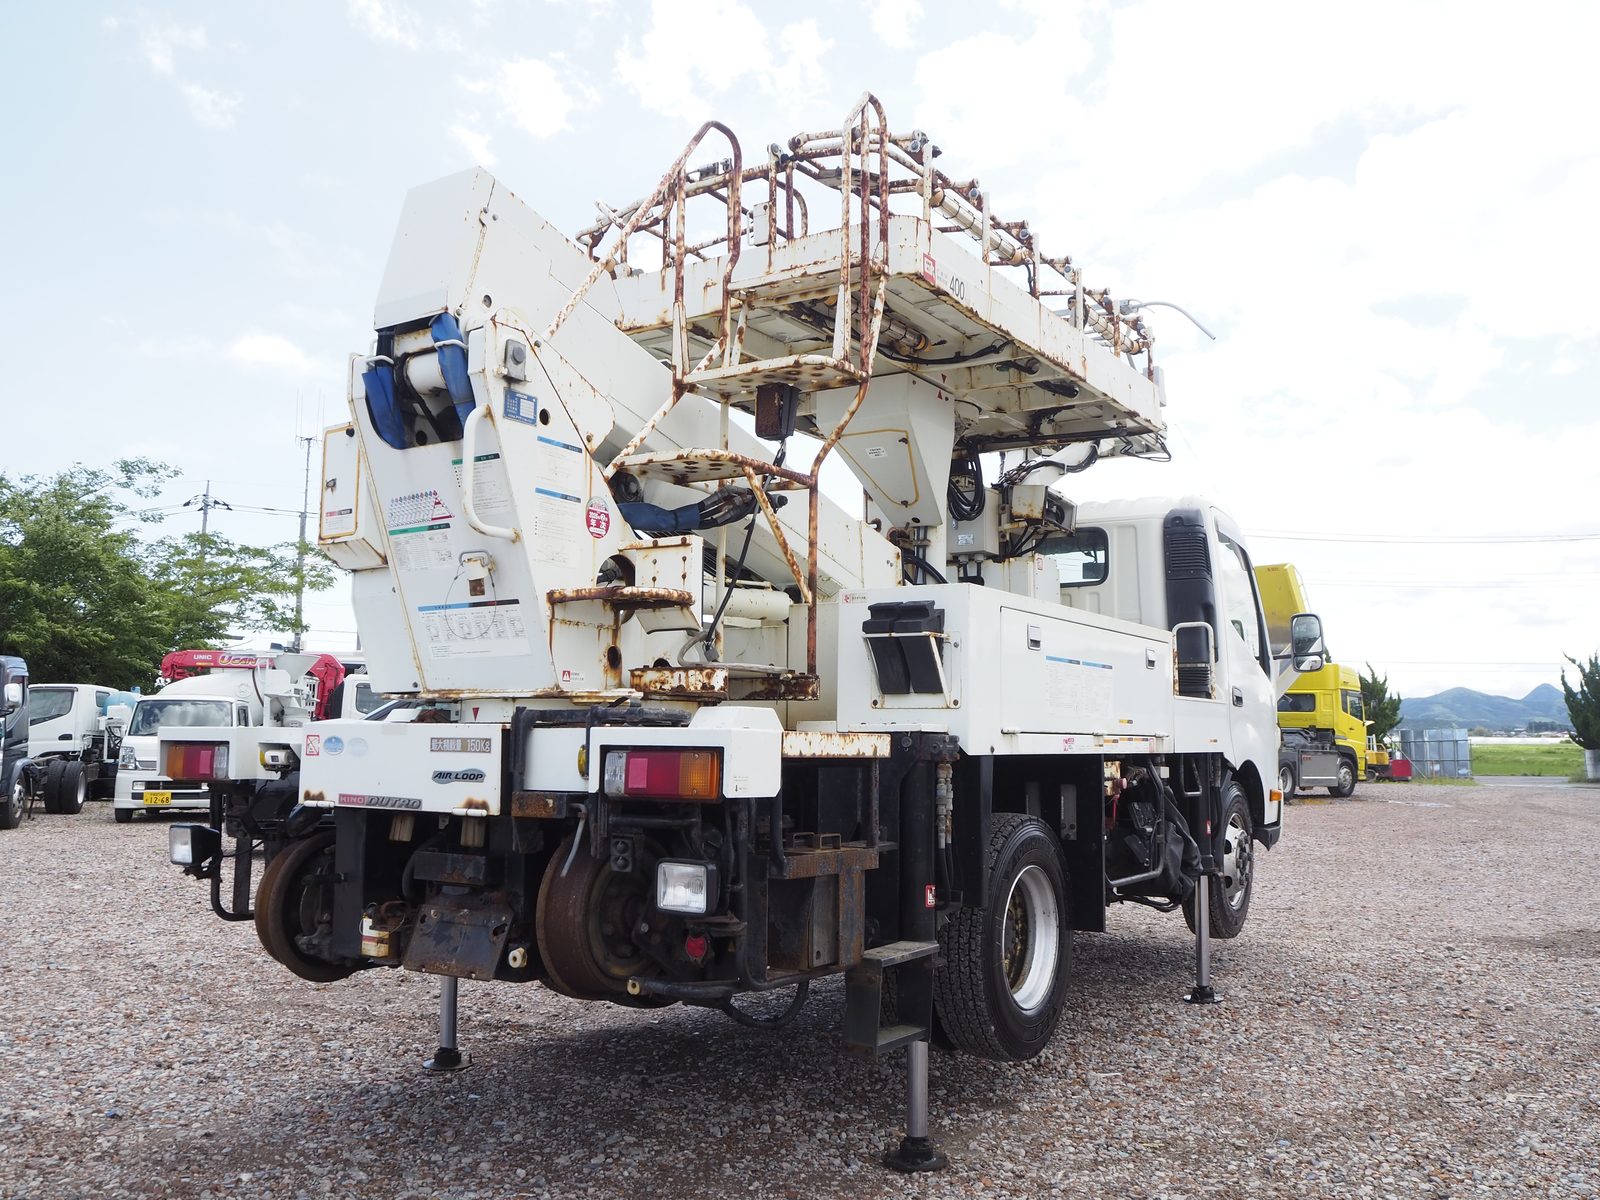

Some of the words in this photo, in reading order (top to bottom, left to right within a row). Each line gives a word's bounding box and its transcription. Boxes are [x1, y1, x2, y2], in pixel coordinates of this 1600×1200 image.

[949, 275, 965, 300] 400
[433, 771, 452, 780] AIR
[454, 772, 483, 781] LOOP
[339, 795, 365, 804] HINO
[366, 795, 422, 809] DUTRO
